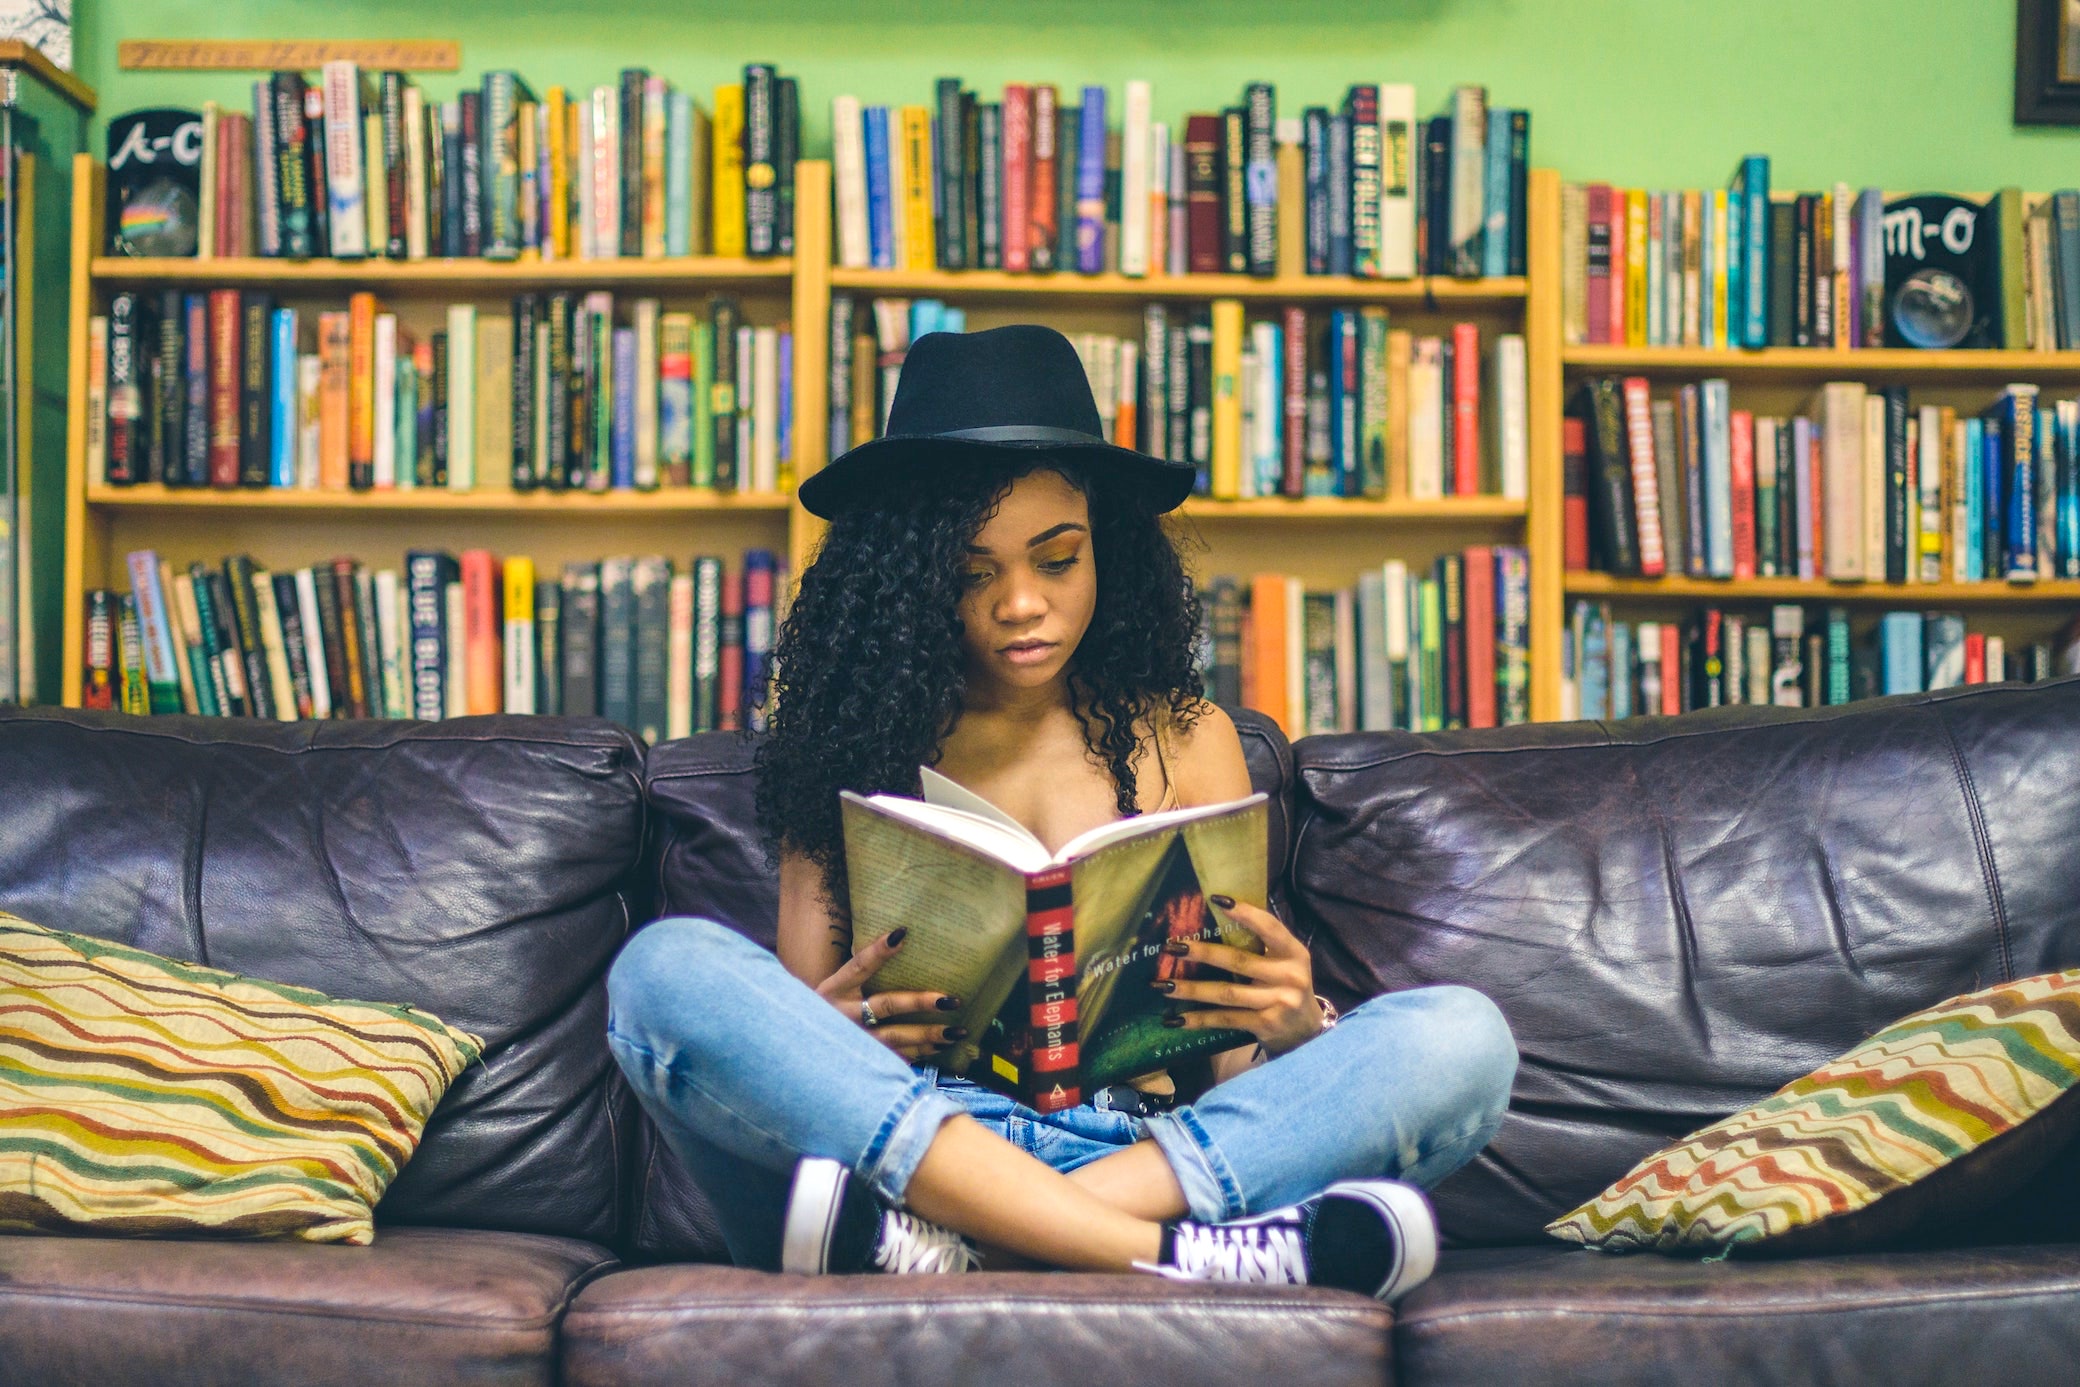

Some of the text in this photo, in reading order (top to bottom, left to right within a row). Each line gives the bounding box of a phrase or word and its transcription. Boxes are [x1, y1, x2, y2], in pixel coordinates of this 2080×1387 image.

[112, 336, 131, 382] BOX
[411, 557, 439, 627] BLUE
[1093, 950, 1138, 978] Water
[1143, 943, 1161, 957] for
[1043, 922, 1066, 1061] Water for Elephants
[1155, 1042, 1192, 1058] SARA
